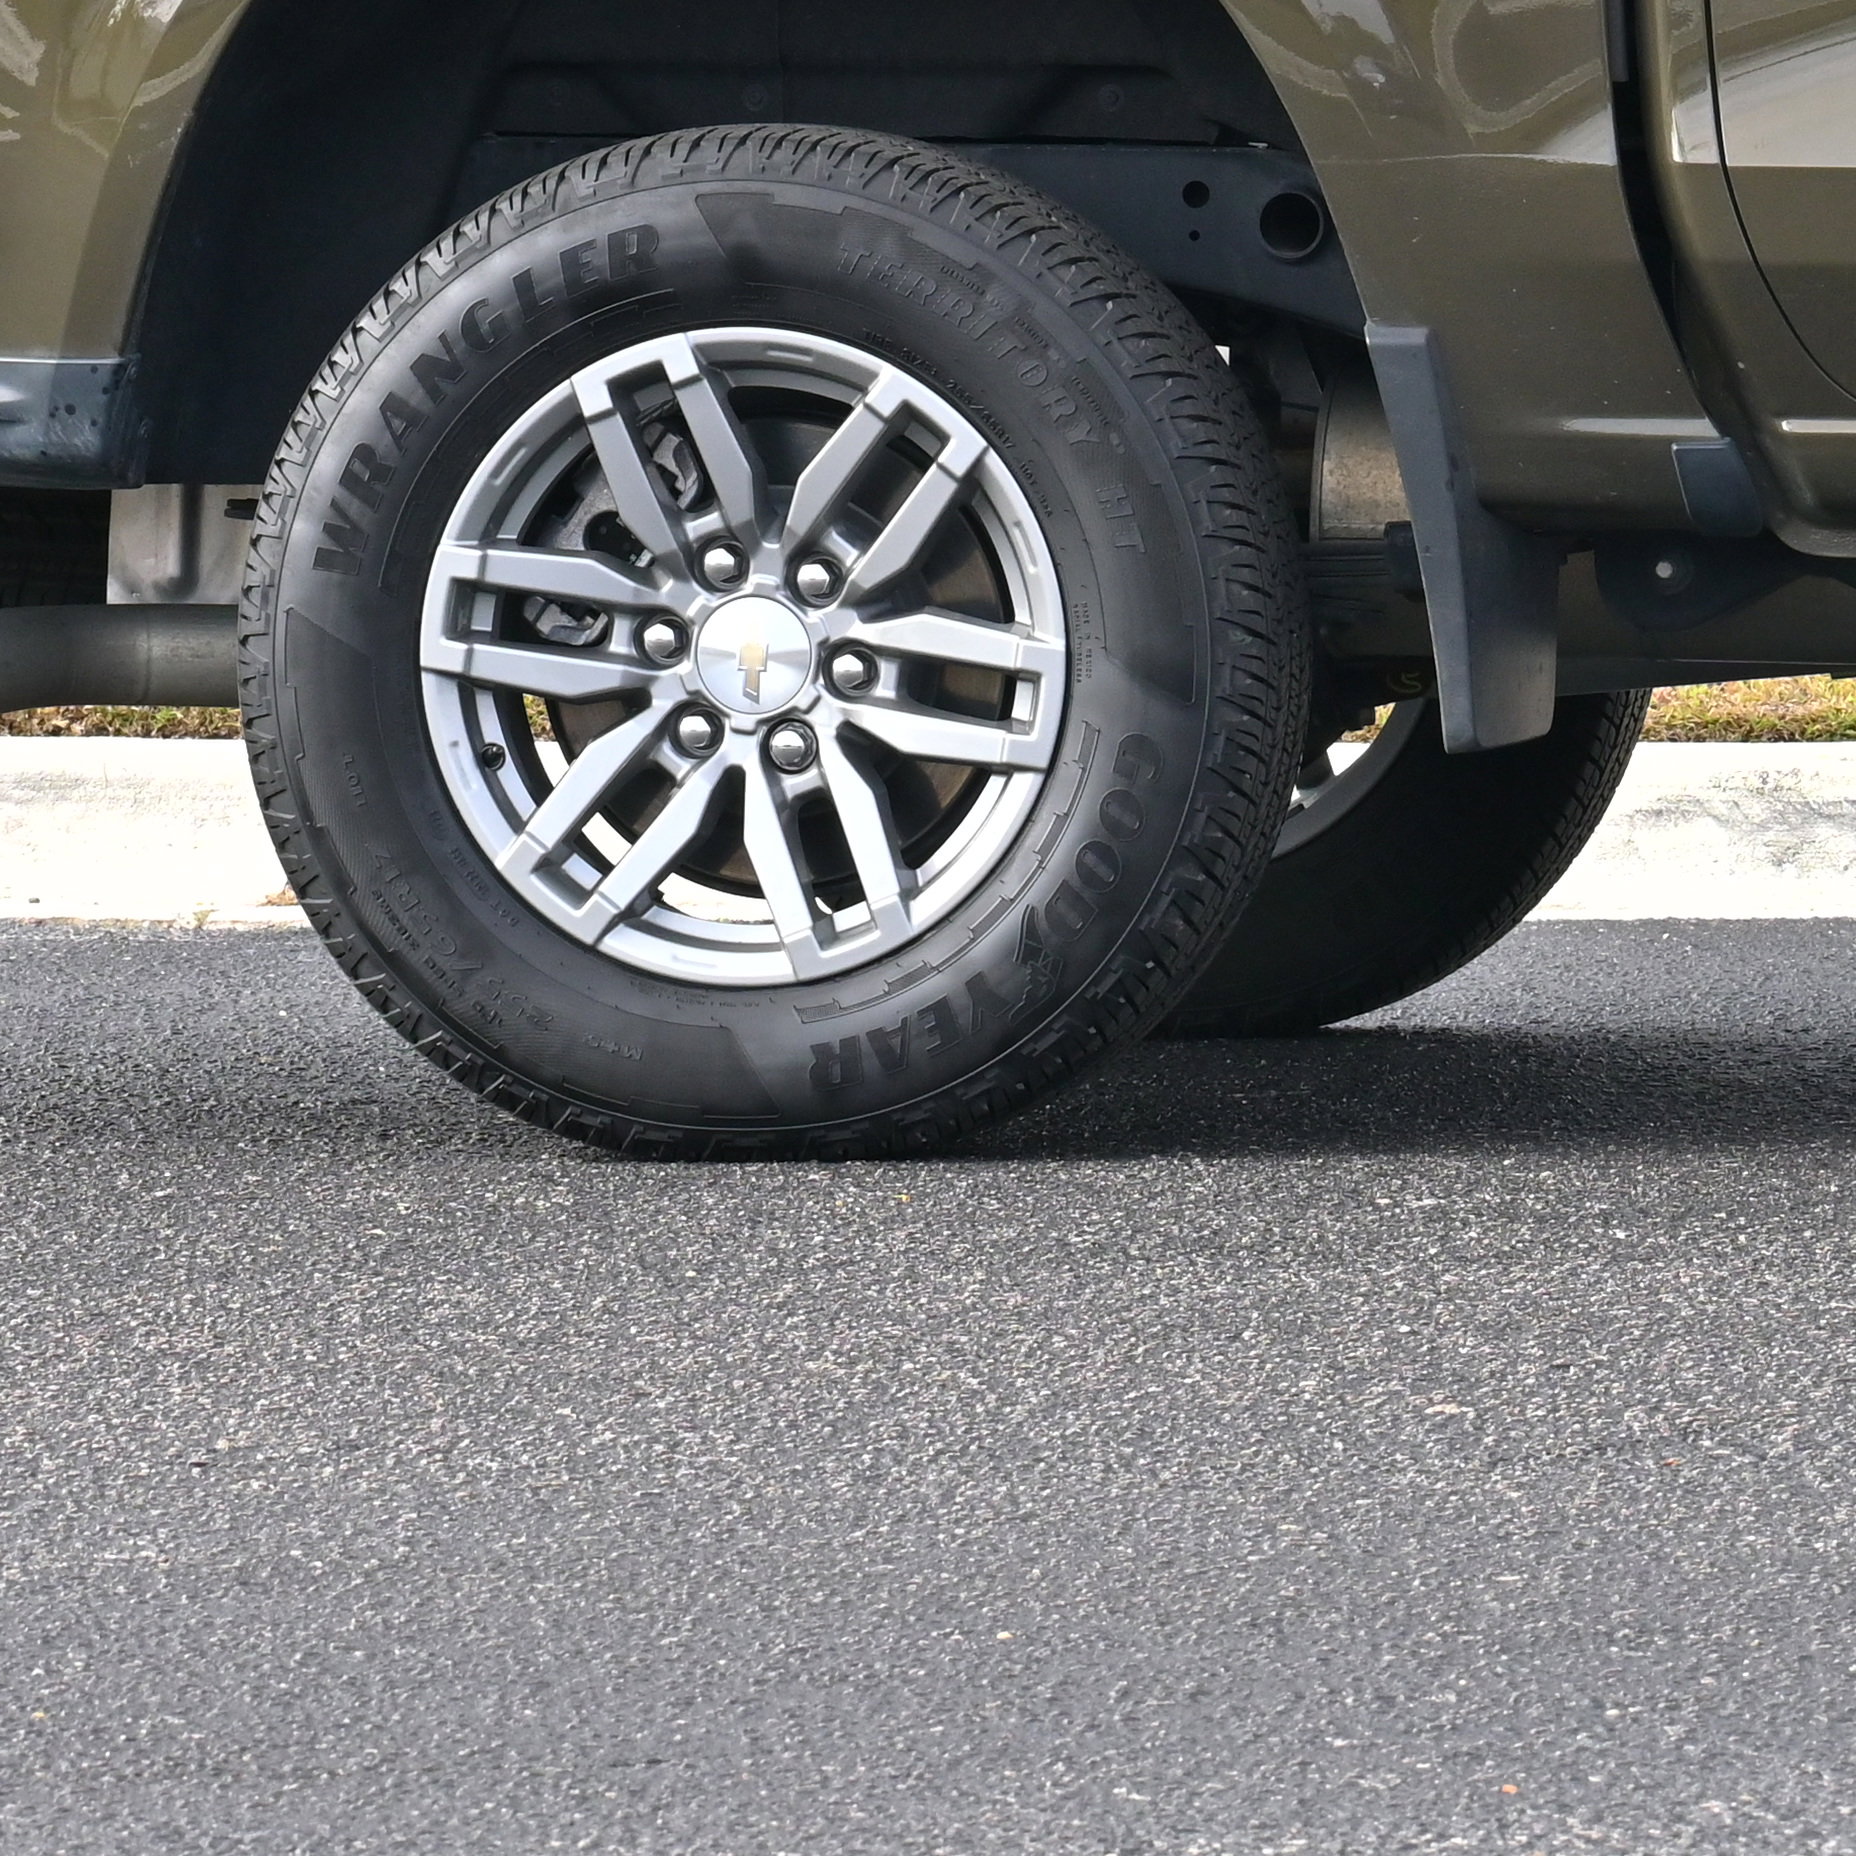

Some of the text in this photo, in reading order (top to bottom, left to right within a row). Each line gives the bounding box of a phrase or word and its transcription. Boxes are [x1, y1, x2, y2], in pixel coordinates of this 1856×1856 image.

[312, 224, 661, 575] WRANGLER
[837, 243, 1147, 553] TERRITORY HT
[364, 842, 555, 1031] 255/65R17
[808, 732, 1165, 1091] GOODYEAR
